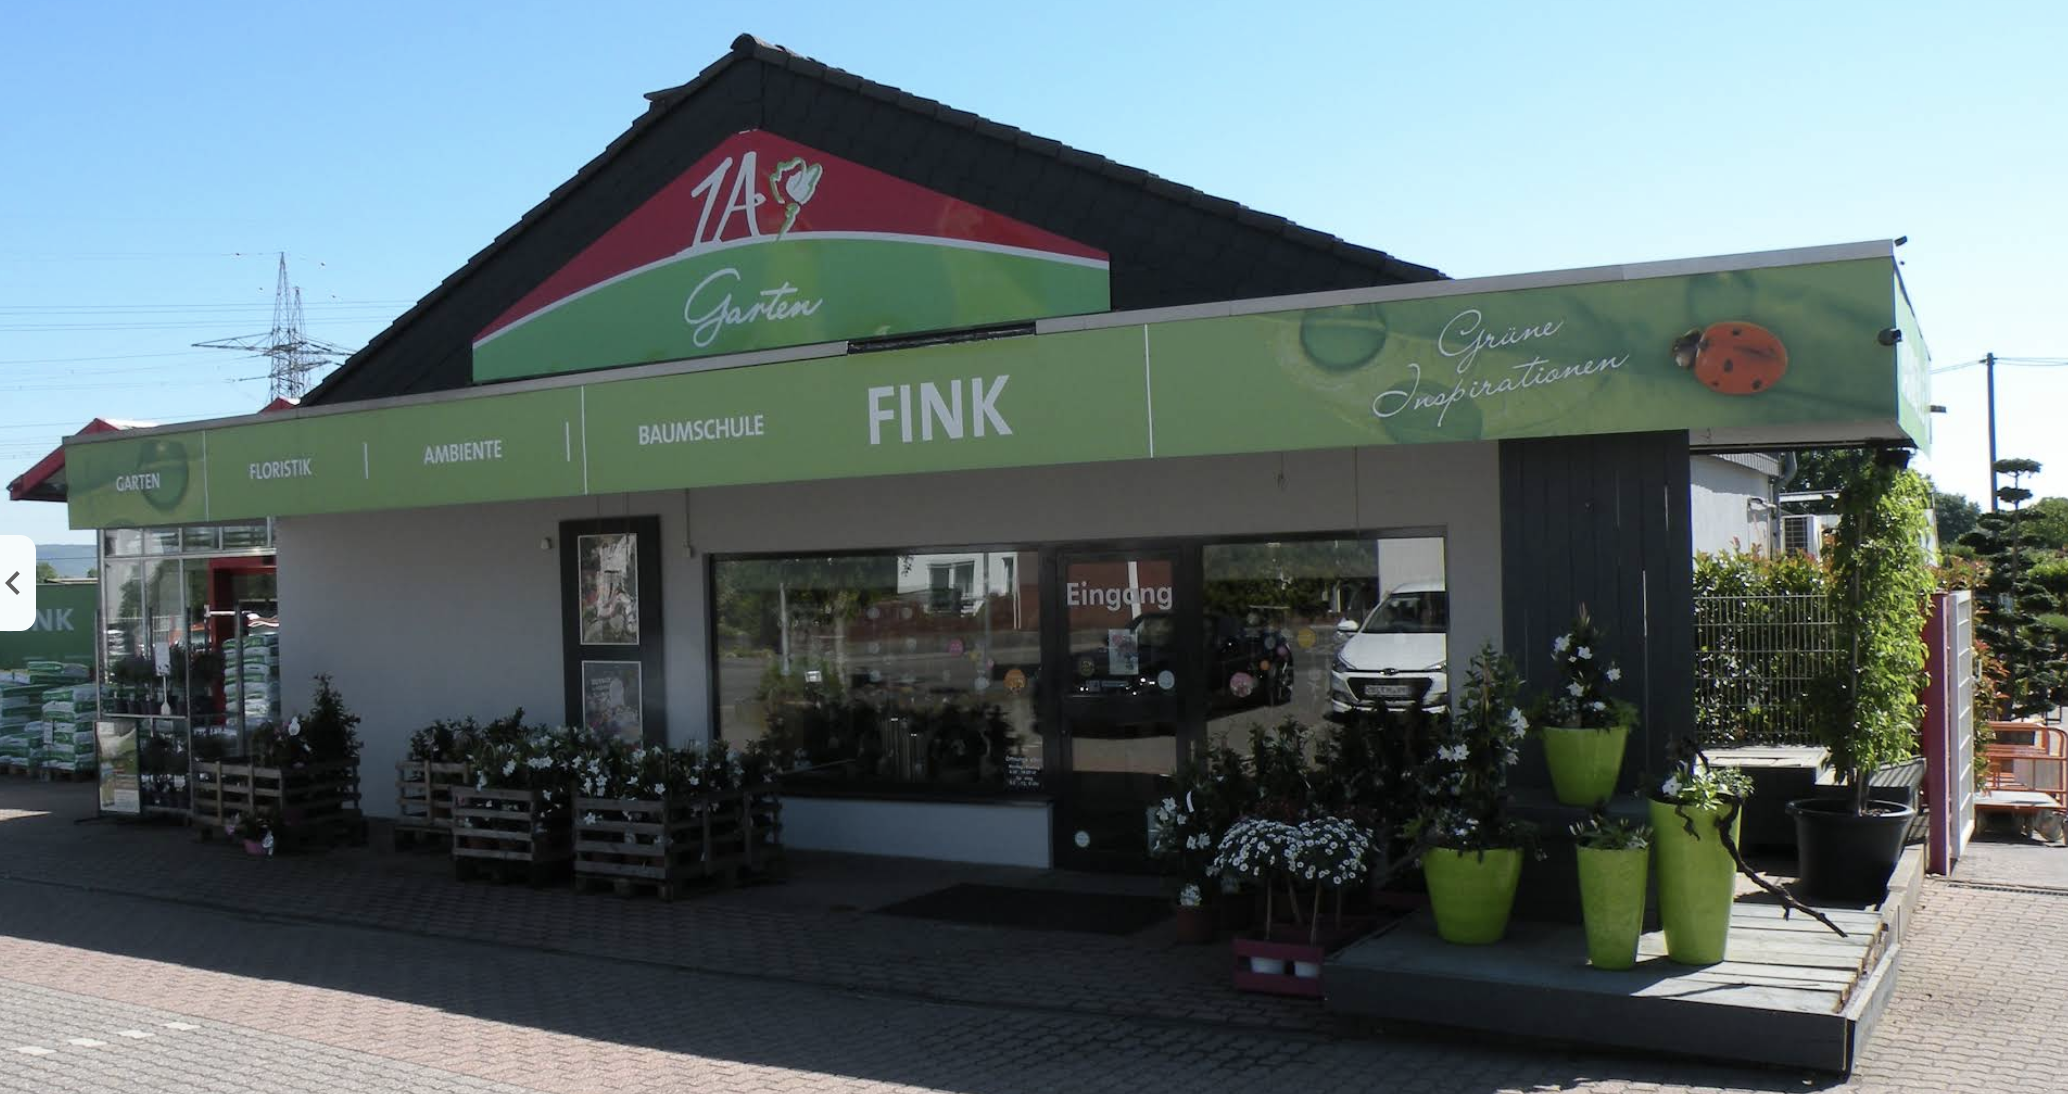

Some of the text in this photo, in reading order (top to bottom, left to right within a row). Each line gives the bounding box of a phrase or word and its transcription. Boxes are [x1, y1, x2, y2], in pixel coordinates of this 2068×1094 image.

[691, 151, 766, 247] 1A
[685, 267, 823, 347] Garten
[1438, 309, 1564, 374] Grüne
[867, 373, 1014, 446] FINK
[1372, 354, 1630, 427] Inspirationen
[423, 438, 503, 466] AMBIENTE
[638, 413, 765, 446] BAUMSCHULE
[115, 473, 161, 493] GARTEN
[249, 457, 312, 480] FLORISTIK
[1066, 580, 1173, 612] Eingang
